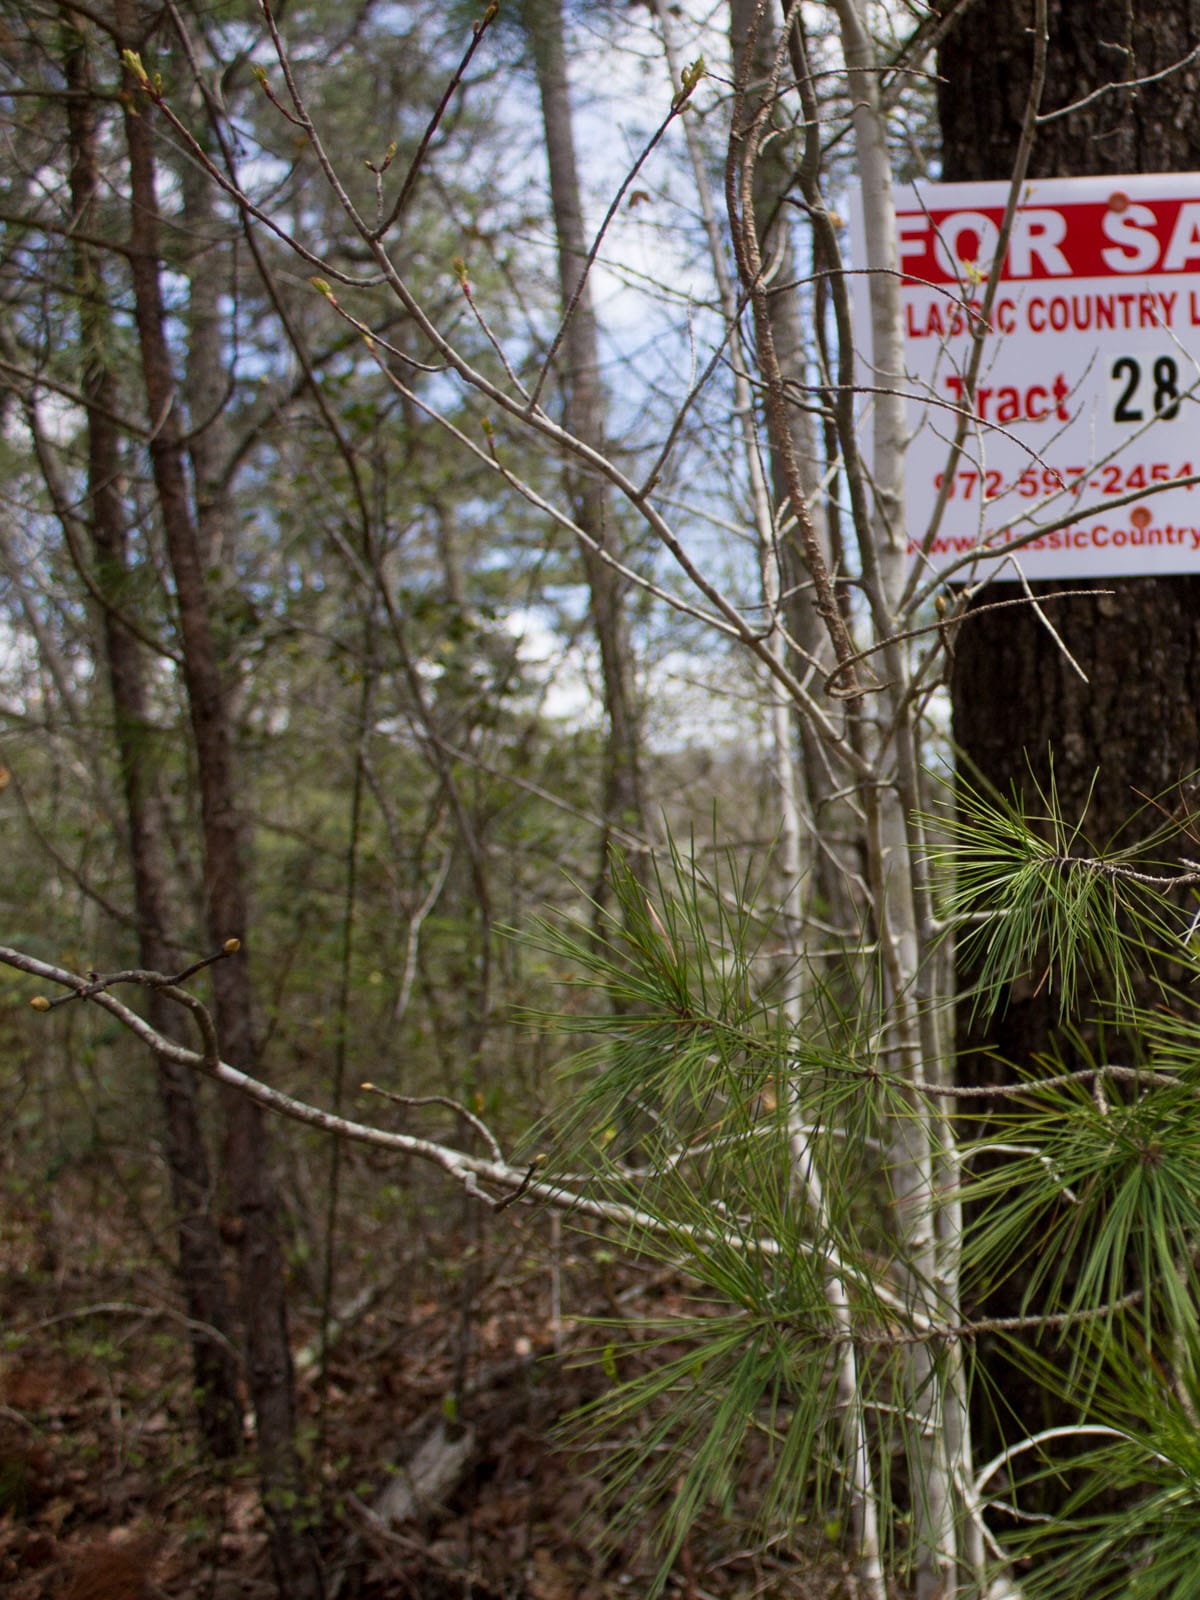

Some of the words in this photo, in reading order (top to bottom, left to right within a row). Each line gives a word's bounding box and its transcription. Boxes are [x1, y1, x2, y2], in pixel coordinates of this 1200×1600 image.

[896, 208, 1073, 281] FOR
[906, 297, 1016, 339] LASSC
[1028, 290, 1177, 333] COUNTRY
[945, 371, 1069, 424] Tract
[1111, 355, 1180, 423] 28
